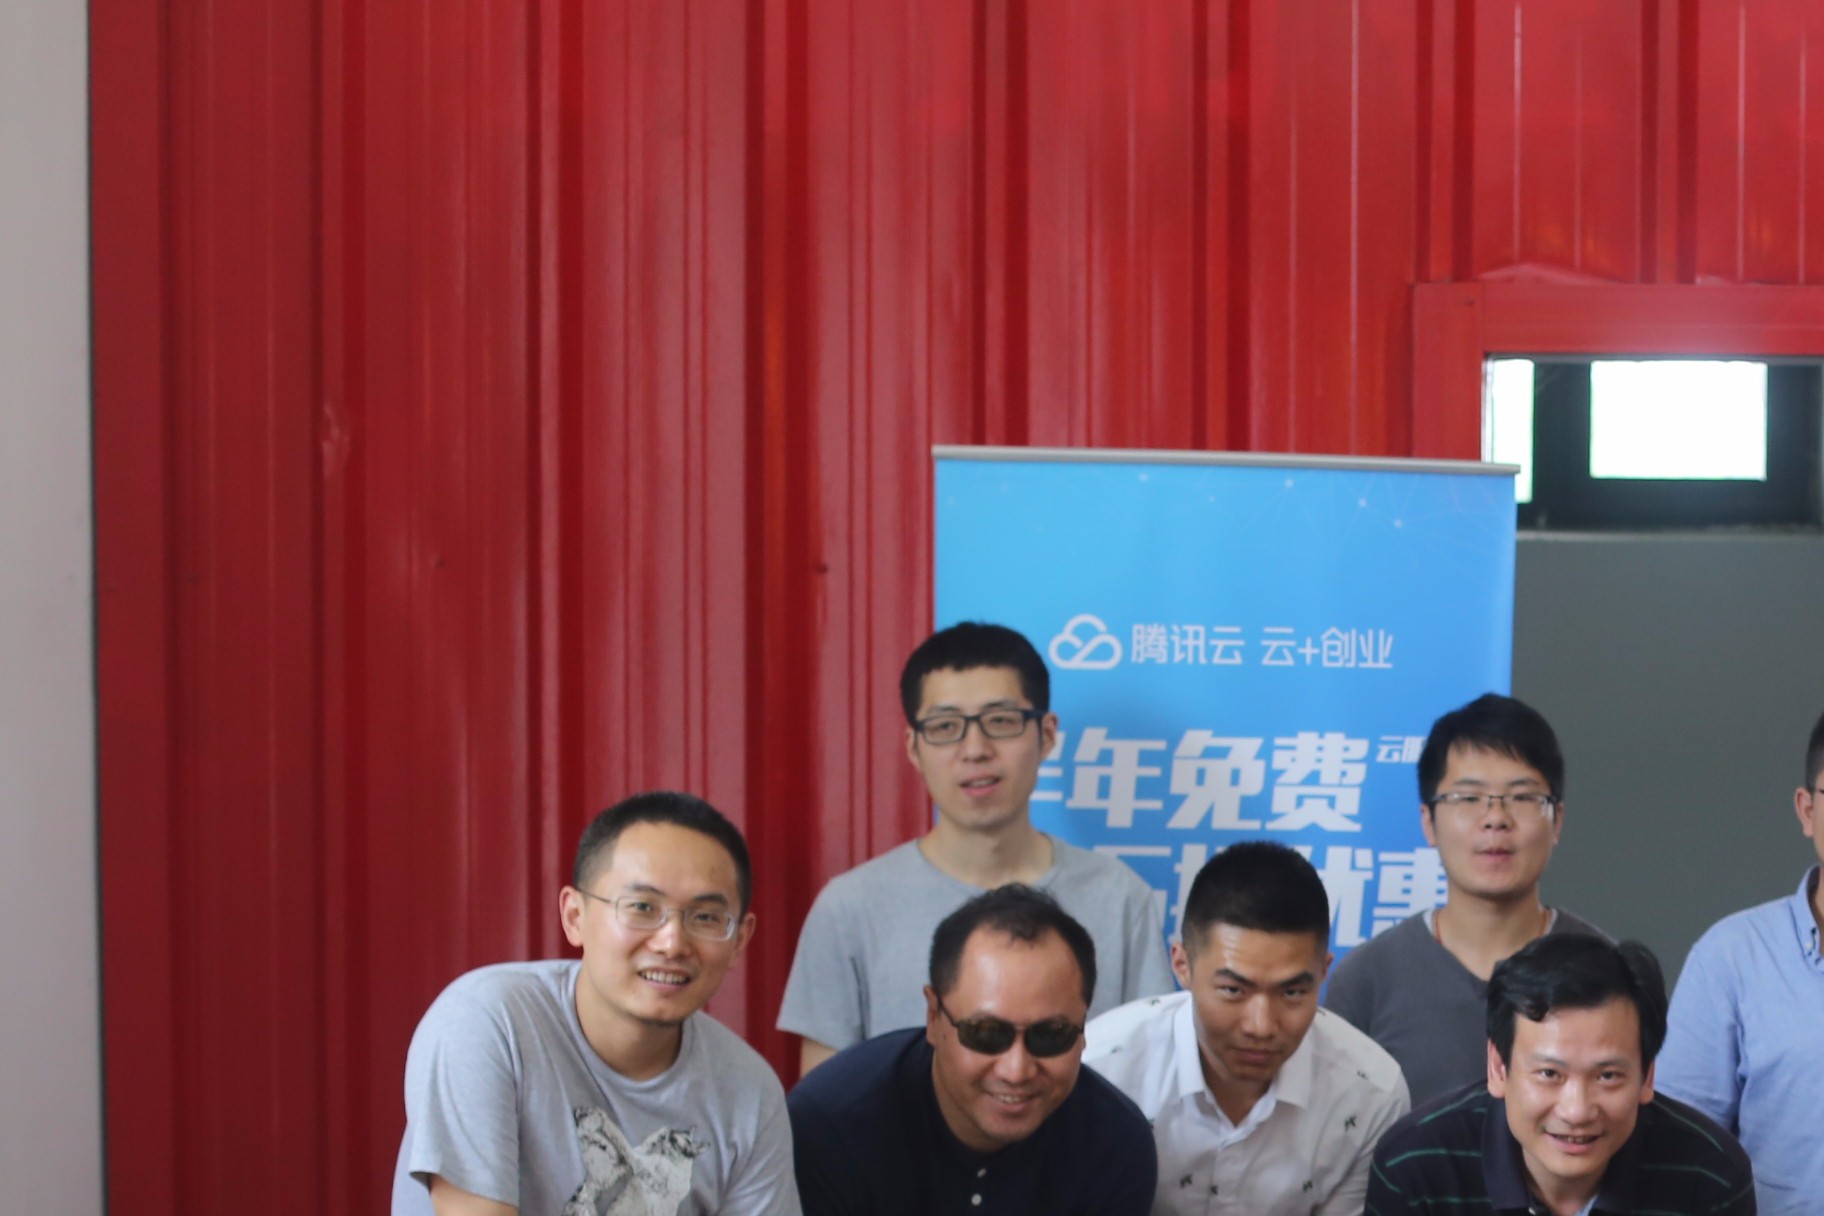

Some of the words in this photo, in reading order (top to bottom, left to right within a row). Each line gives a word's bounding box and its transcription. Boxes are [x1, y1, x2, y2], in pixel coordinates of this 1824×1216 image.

[1130, 623, 1246, 665] 腾讯云
[1260, 626, 1395, 669] 云+创业
